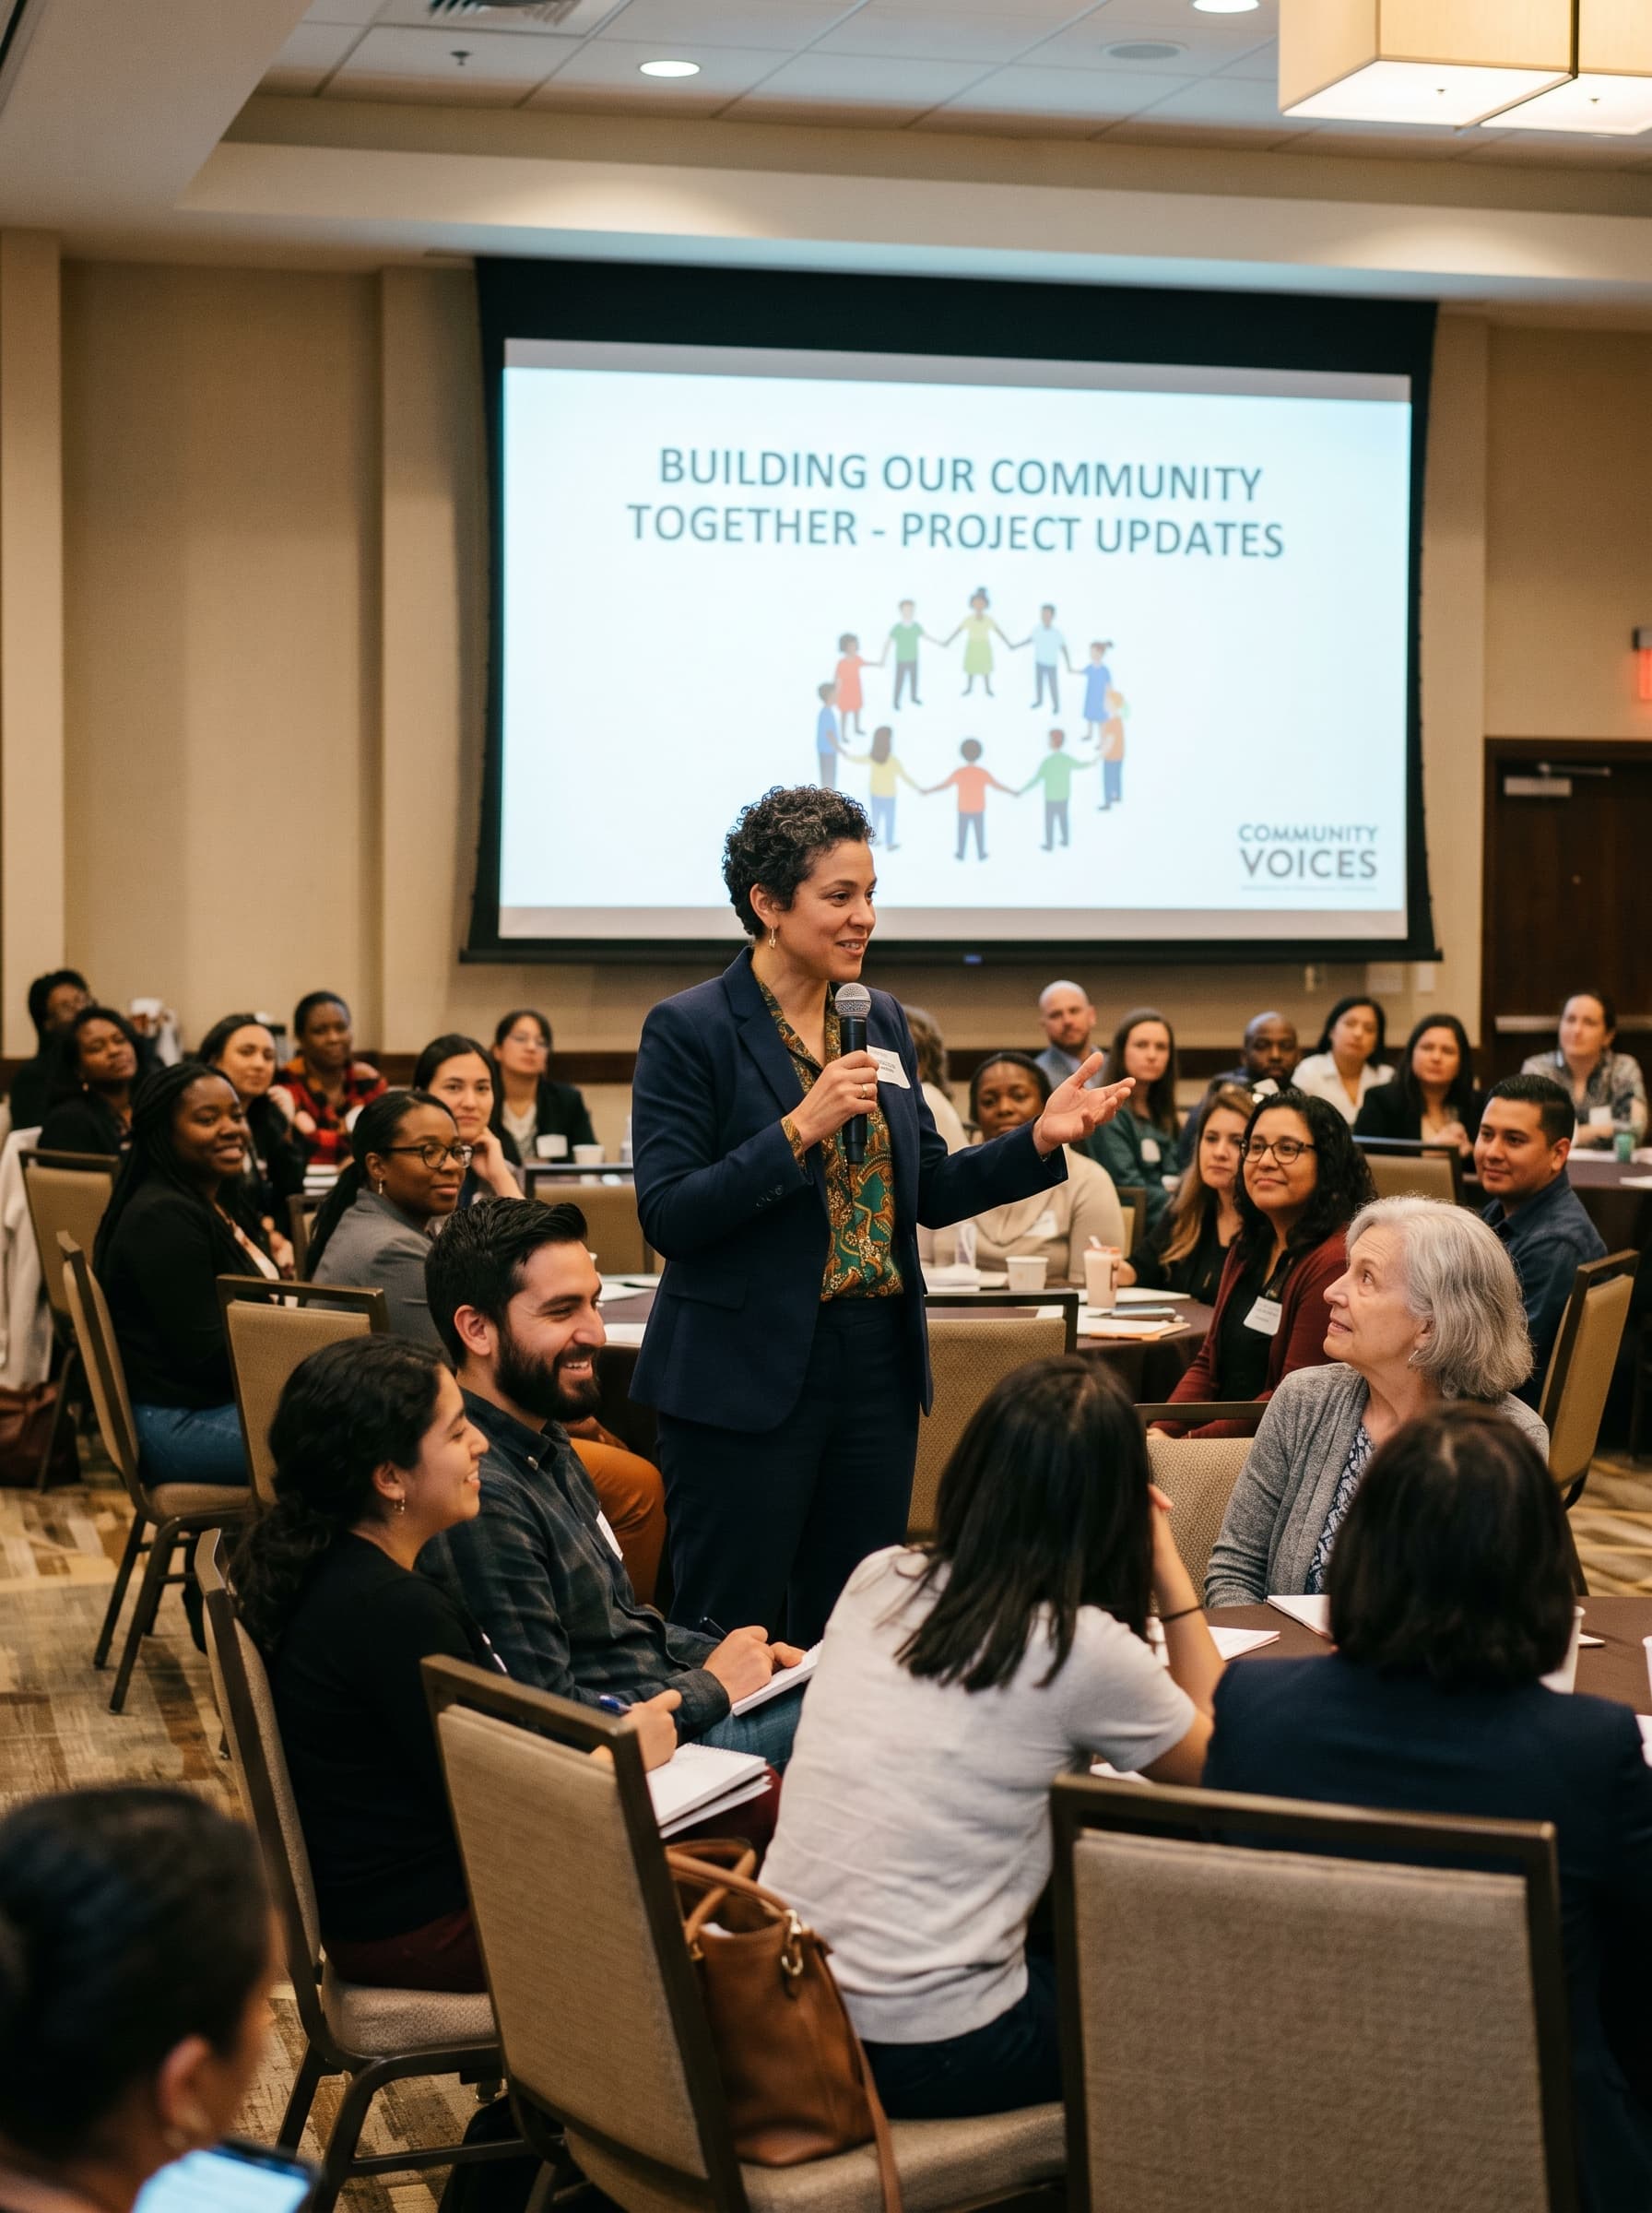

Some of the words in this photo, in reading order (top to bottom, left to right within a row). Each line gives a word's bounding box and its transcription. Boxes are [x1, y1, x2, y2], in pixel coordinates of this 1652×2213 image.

[660, 447, 867, 491] BUILDING
[881, 454, 976, 494] OUR
[989, 457, 1263, 503] COMMUNITY
[626, 503, 857, 546] TOGETHER
[901, 511, 1082, 552] PROJECT
[1095, 517, 1285, 560] UPDATES
[1238, 823, 1378, 843] COMMUNITY
[1239, 847, 1378, 880] VOICES
